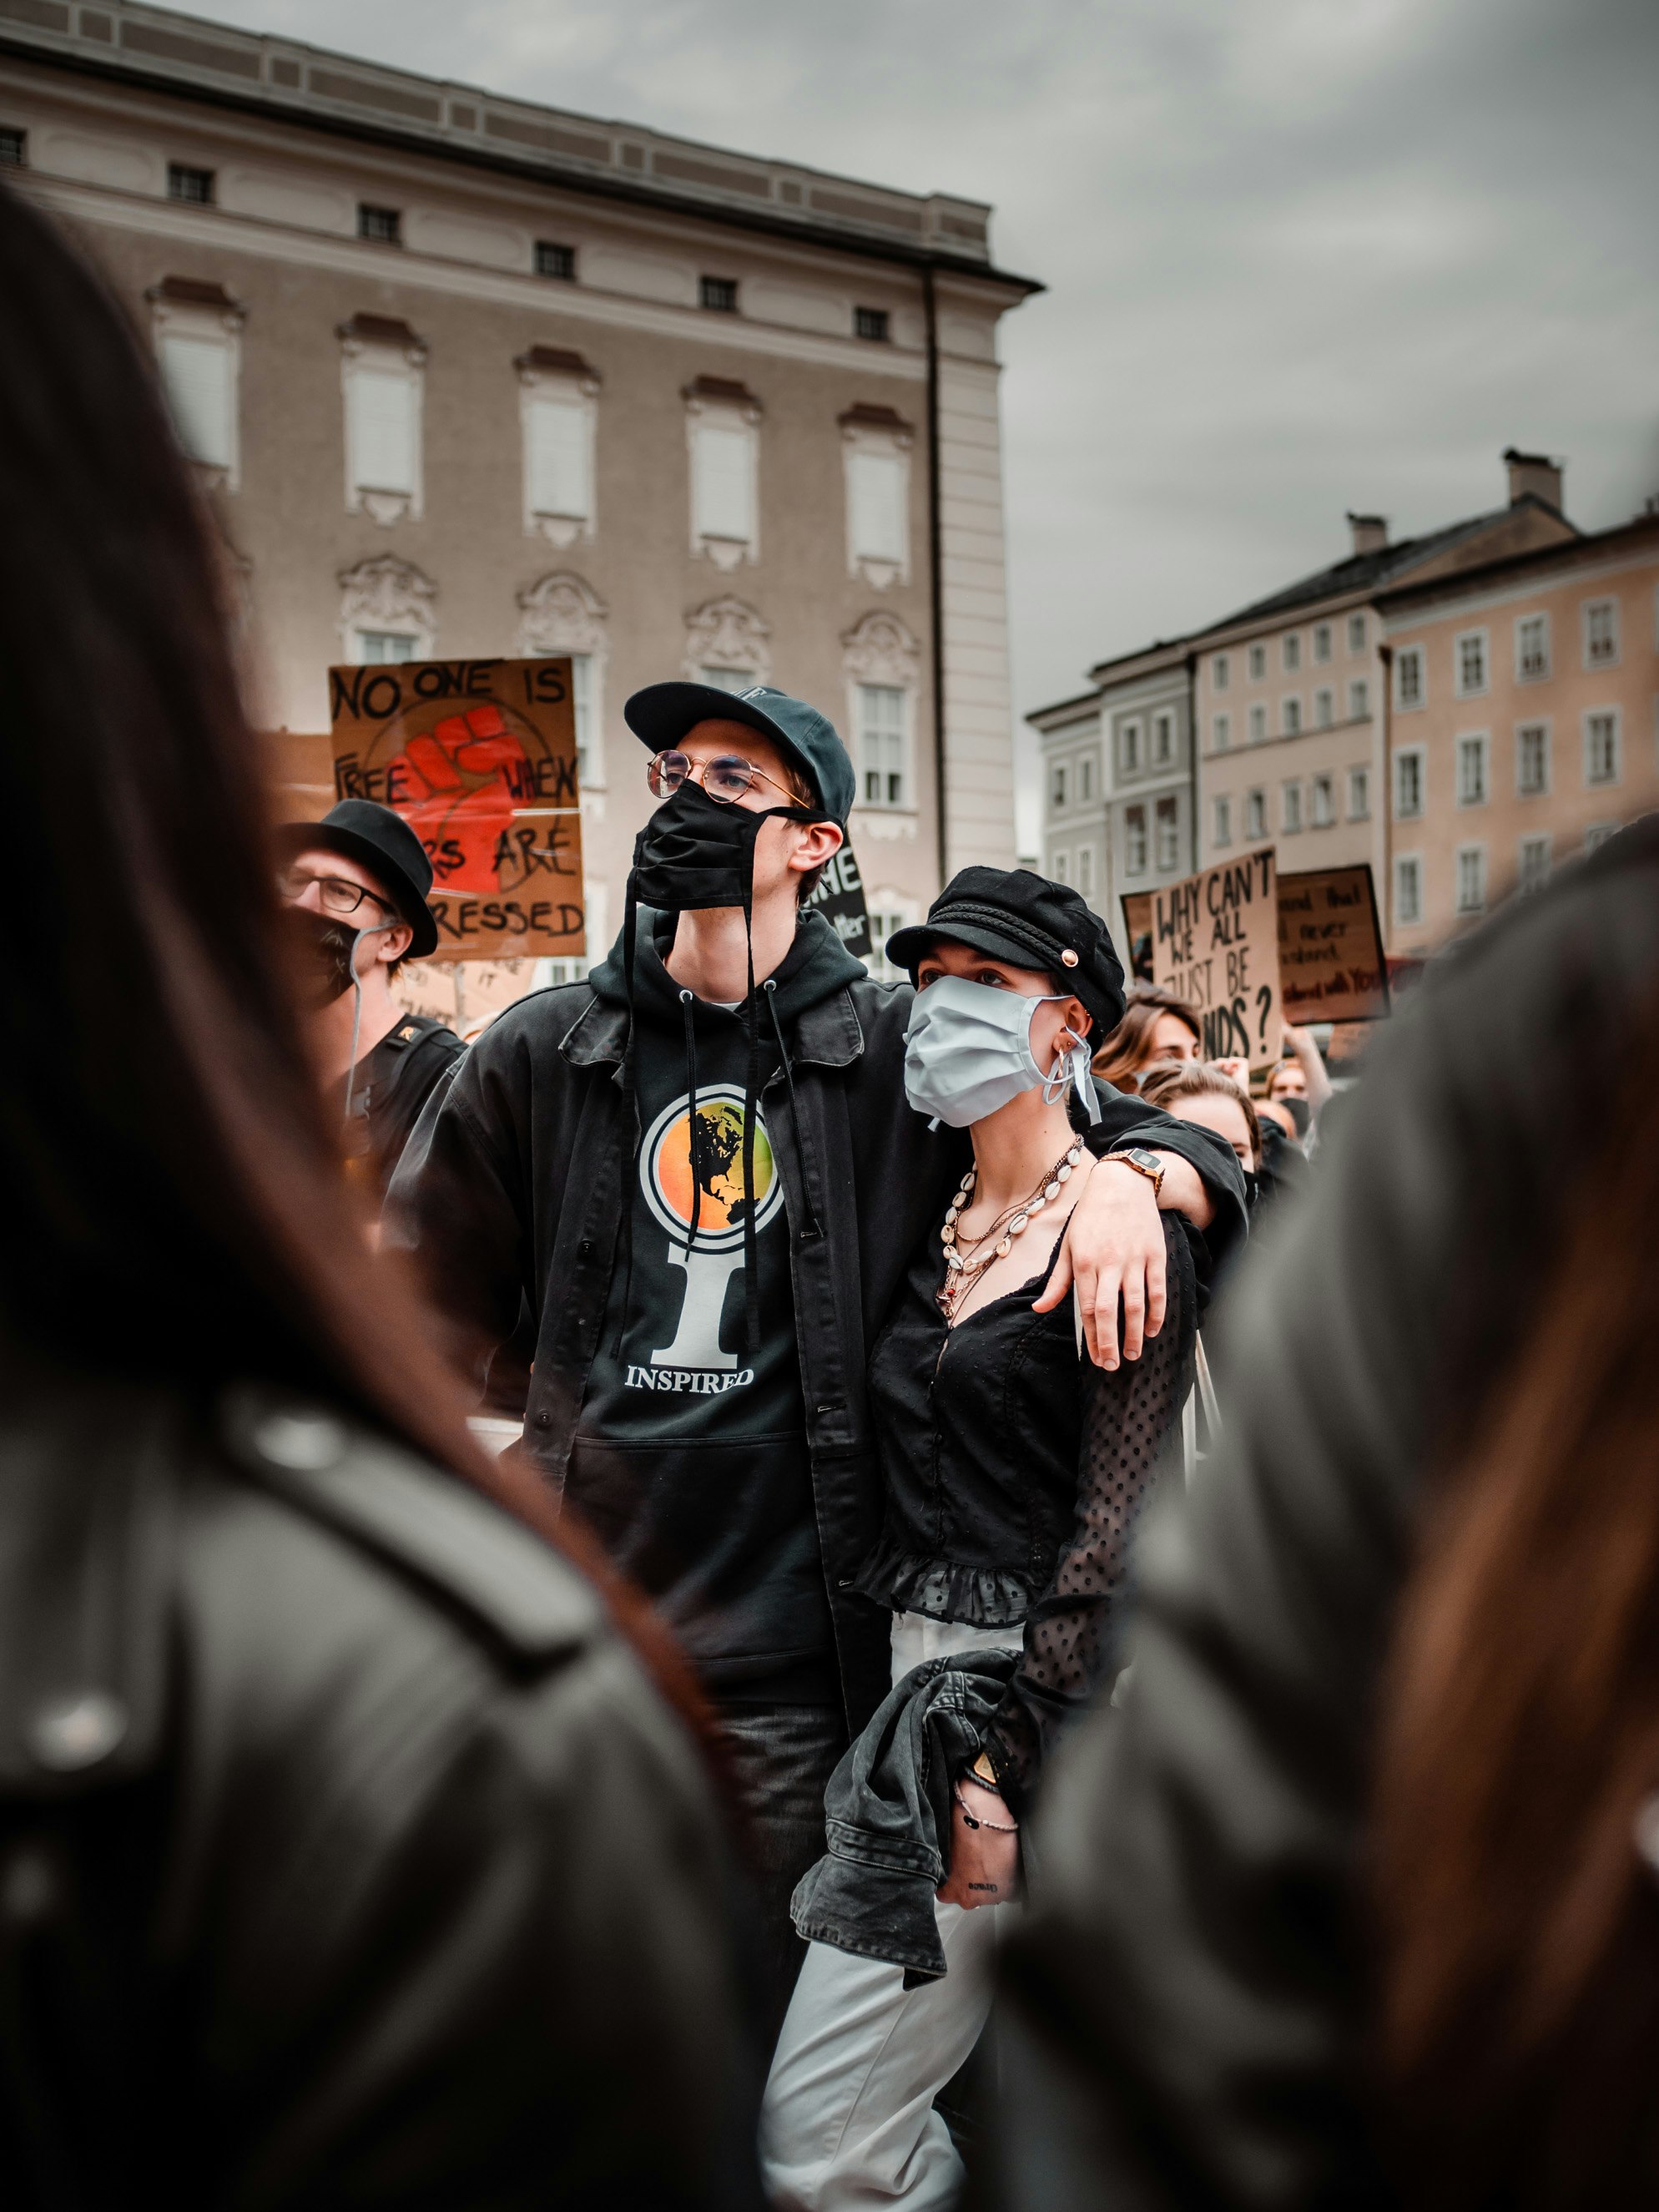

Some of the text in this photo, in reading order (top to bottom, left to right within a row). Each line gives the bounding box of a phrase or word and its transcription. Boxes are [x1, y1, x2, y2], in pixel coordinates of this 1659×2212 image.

[330, 662, 567, 720] NO ONE IS
[335, 753, 578, 804] FREE WHEN
[492, 827, 576, 876] ARE
[1157, 879, 1203, 943] WHY
[1207, 850, 1273, 917] CAN'T
[1171, 928, 1193, 967] WE
[1212, 912, 1247, 951] ALL
[1227, 947, 1250, 997] BE
[624, 1365, 754, 1394] INSPIRED
